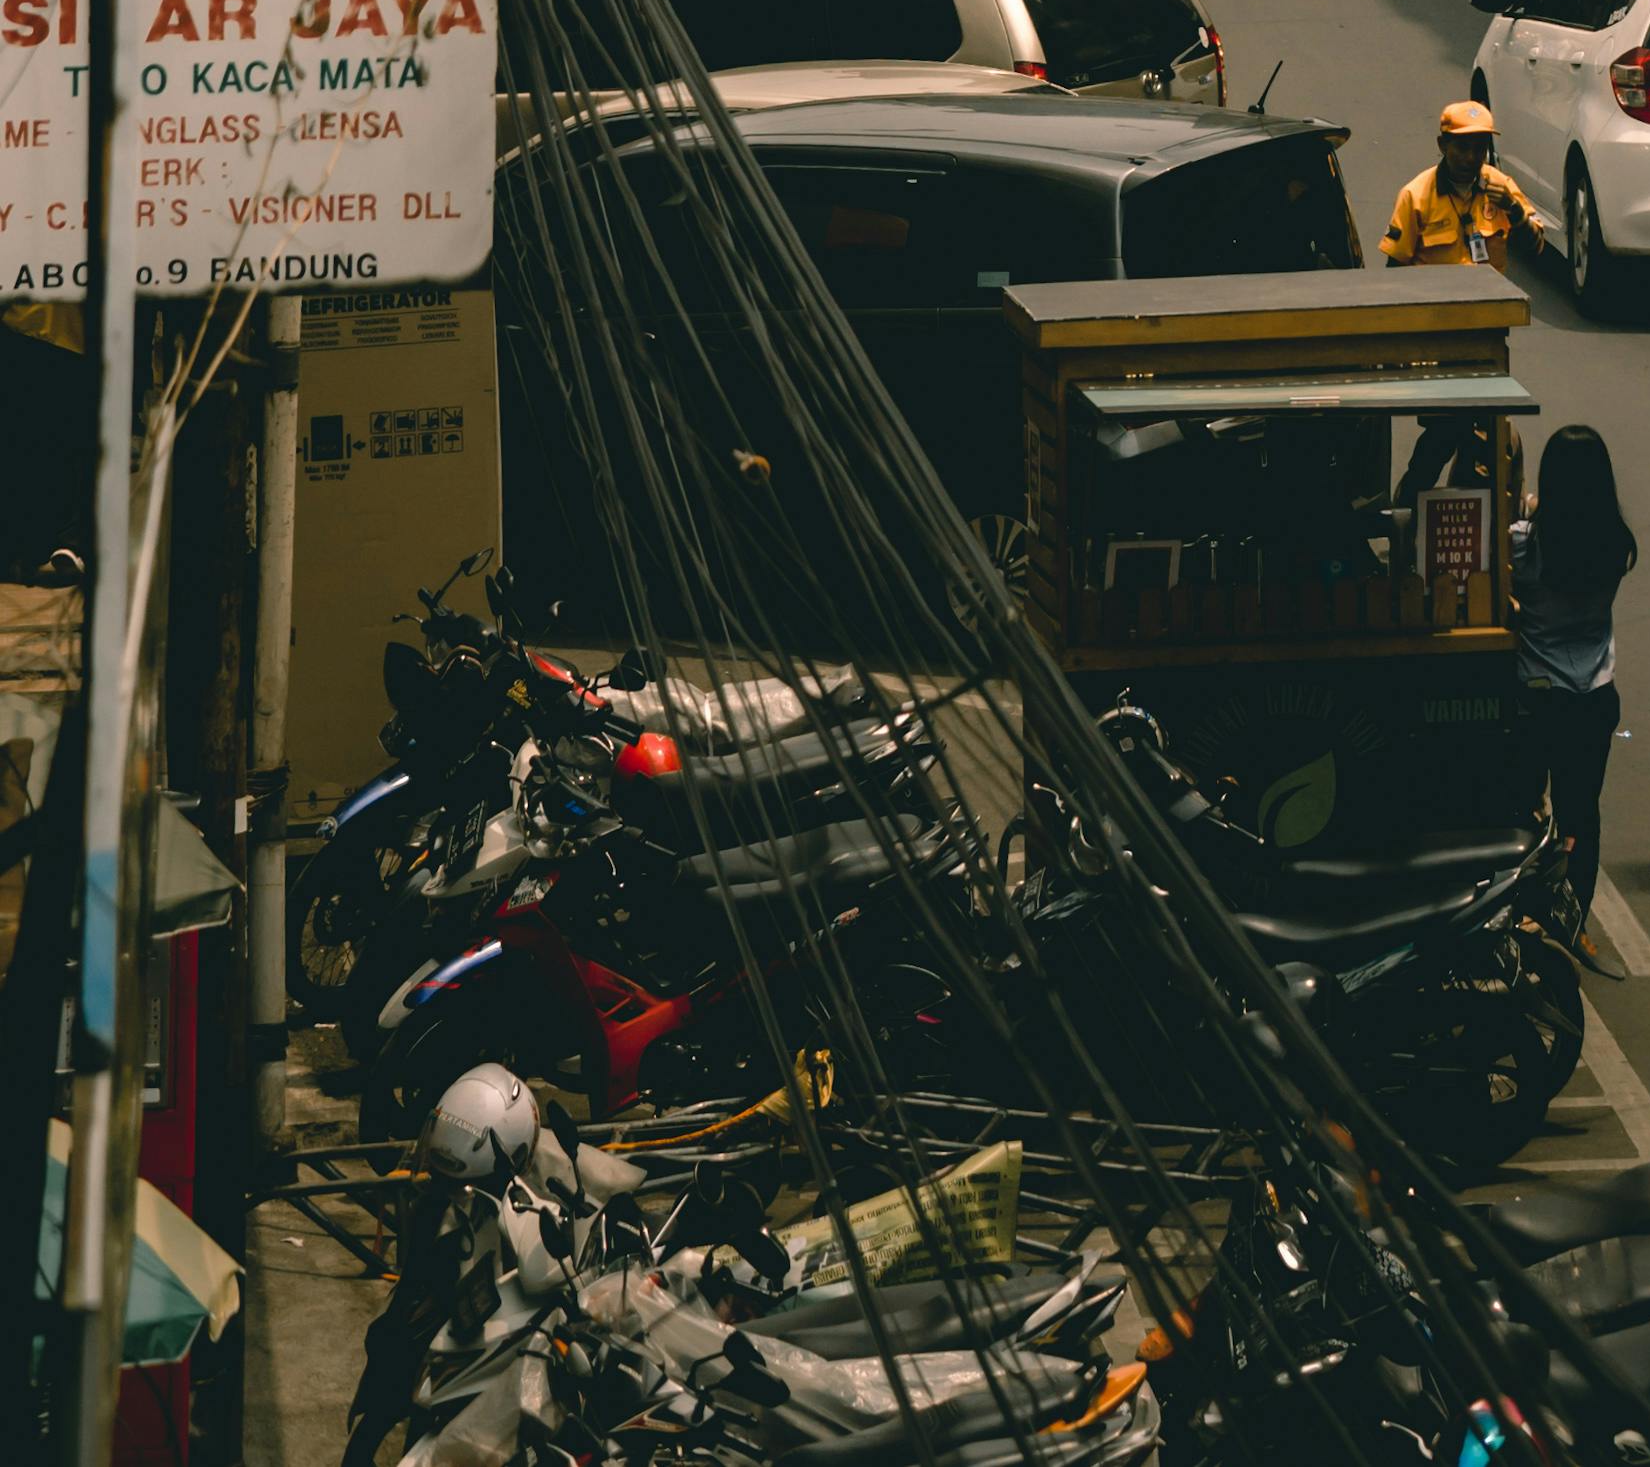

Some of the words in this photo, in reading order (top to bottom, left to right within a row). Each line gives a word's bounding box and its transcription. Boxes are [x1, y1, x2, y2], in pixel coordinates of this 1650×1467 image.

[64, 63, 168, 97] TO
[193, 60, 295, 95] KACA
[319, 56, 427, 91] MATA
[138, 113, 261, 145] NGLASS
[299, 110, 403, 142] LENSA
[140, 157, 206, 187] ERK
[228, 191, 378, 226] VISIONER
[403, 192, 462, 221] DLL
[210, 253, 378, 285] BANDUNG
[1423, 697, 1501, 723] VARIAN
